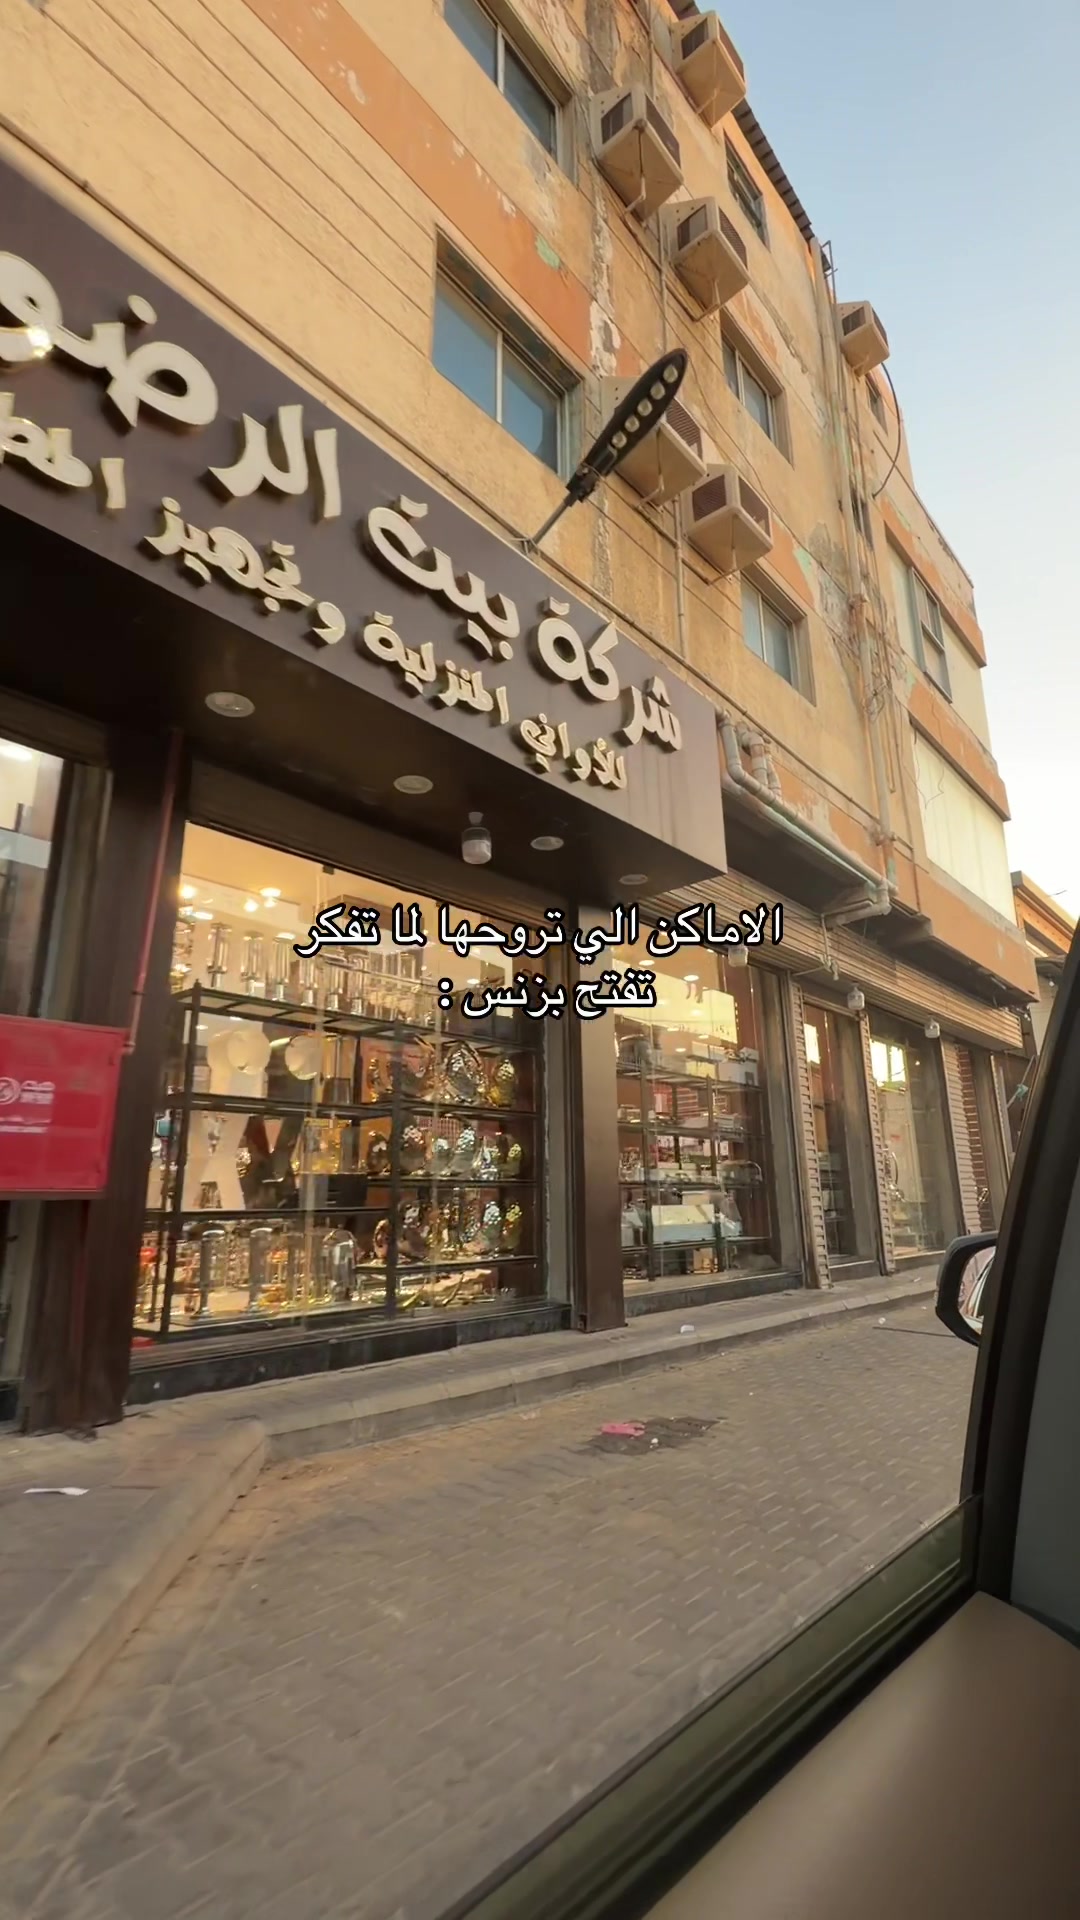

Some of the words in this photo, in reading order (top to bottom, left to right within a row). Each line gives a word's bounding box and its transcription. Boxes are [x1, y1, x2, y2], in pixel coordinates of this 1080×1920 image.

[368, 494, 521, 661] بيت
[364, 610, 510, 726] المنزلية
[537, 597, 683, 751] شركة
